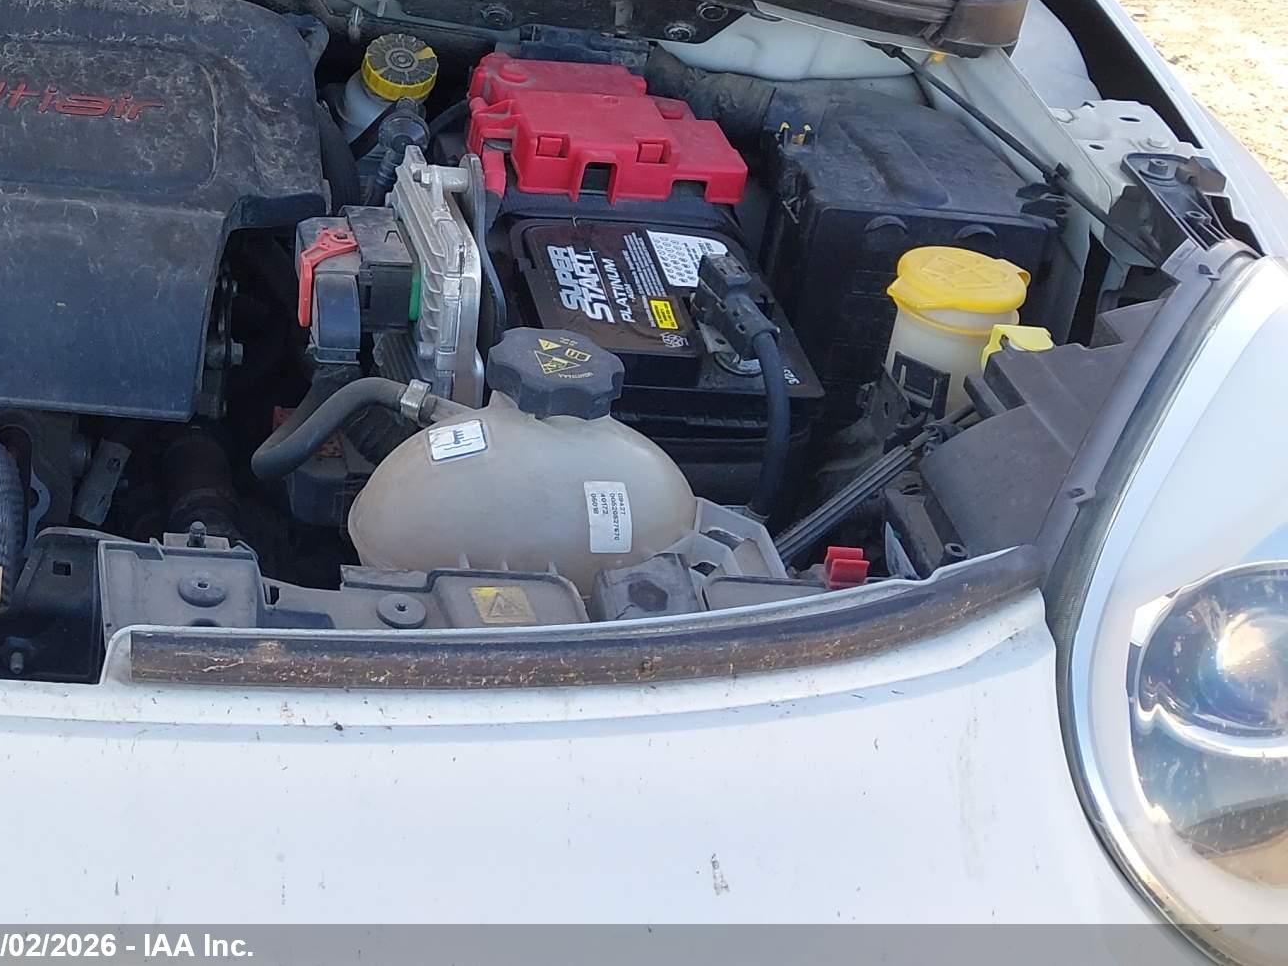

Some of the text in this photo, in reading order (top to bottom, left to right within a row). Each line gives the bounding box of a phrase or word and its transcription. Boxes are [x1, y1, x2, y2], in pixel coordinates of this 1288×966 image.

[547, 245, 584, 311] SUPER
[567, 245, 616, 324] START
[601, 257, 636, 323] PLATINUM
